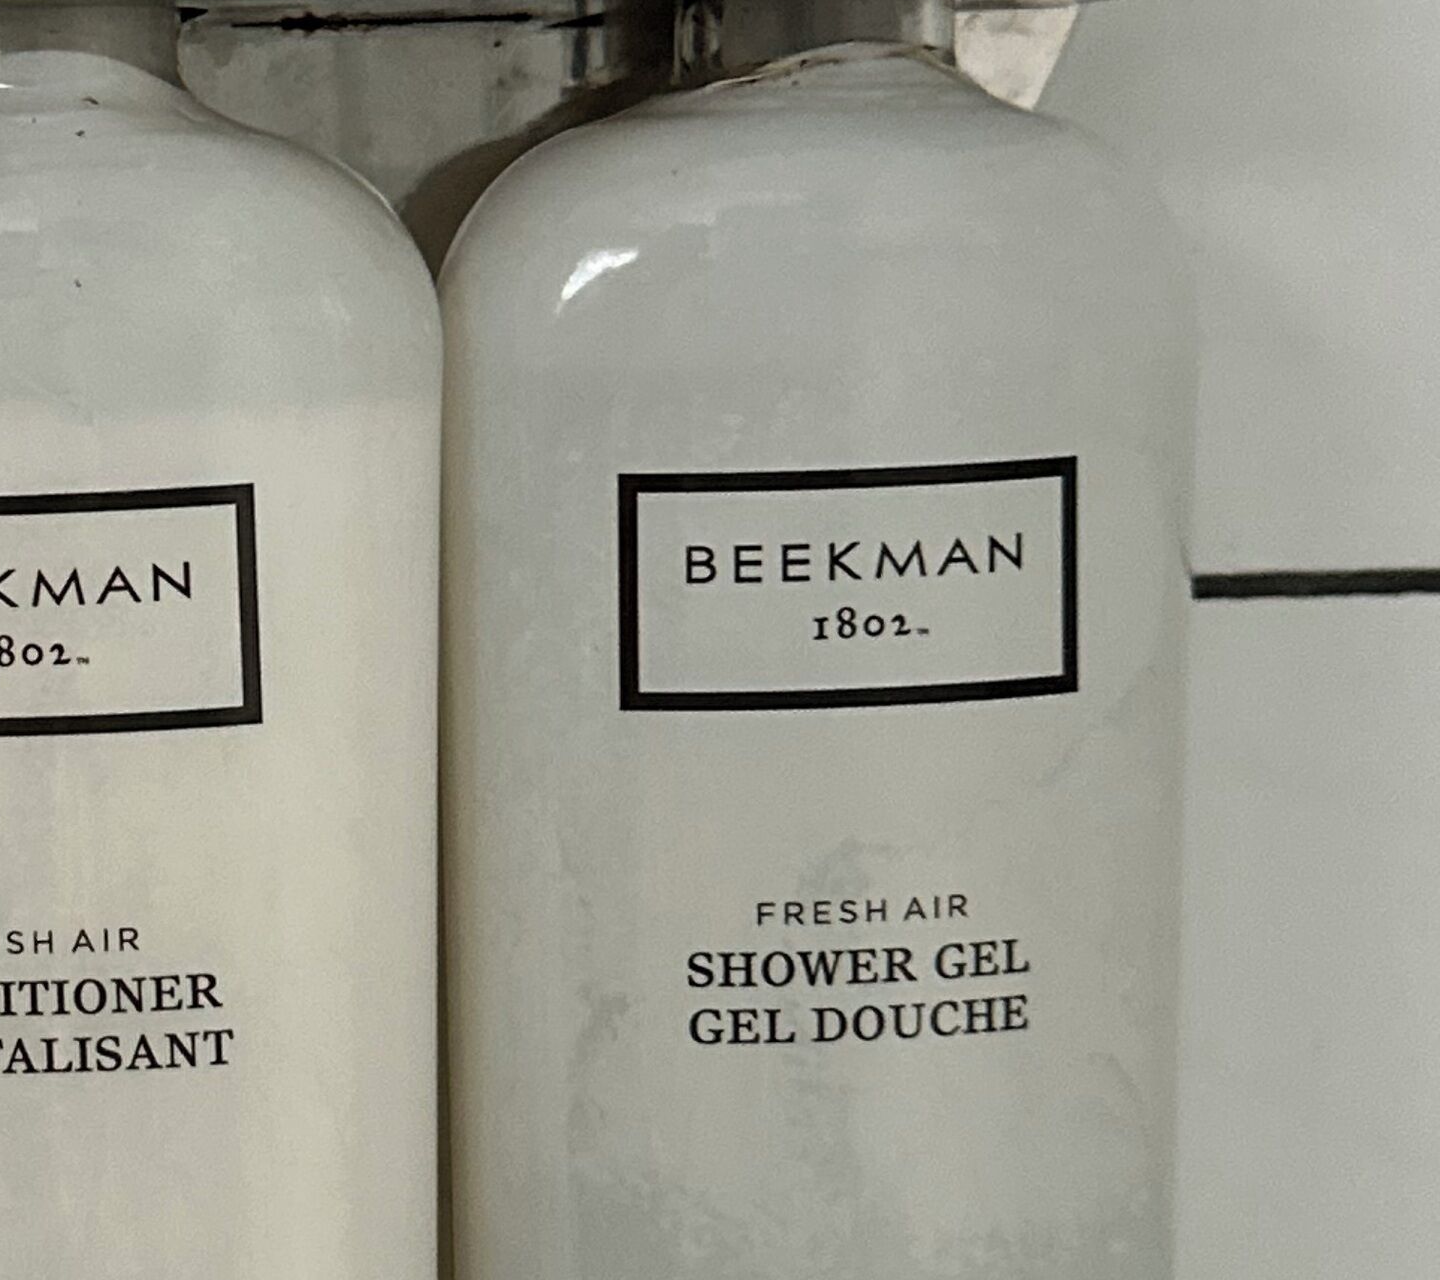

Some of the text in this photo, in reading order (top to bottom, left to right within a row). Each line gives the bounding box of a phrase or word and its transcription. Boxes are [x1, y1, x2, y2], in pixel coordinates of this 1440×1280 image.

[685, 531, 1024, 586] BEEKMAN
[755, 893, 969, 928] FRESH AIR
[70, 926, 140, 955] AIR
[686, 938, 1032, 989] SHOWER GEL
[688, 993, 1030, 1047] GEL DOUCHE
